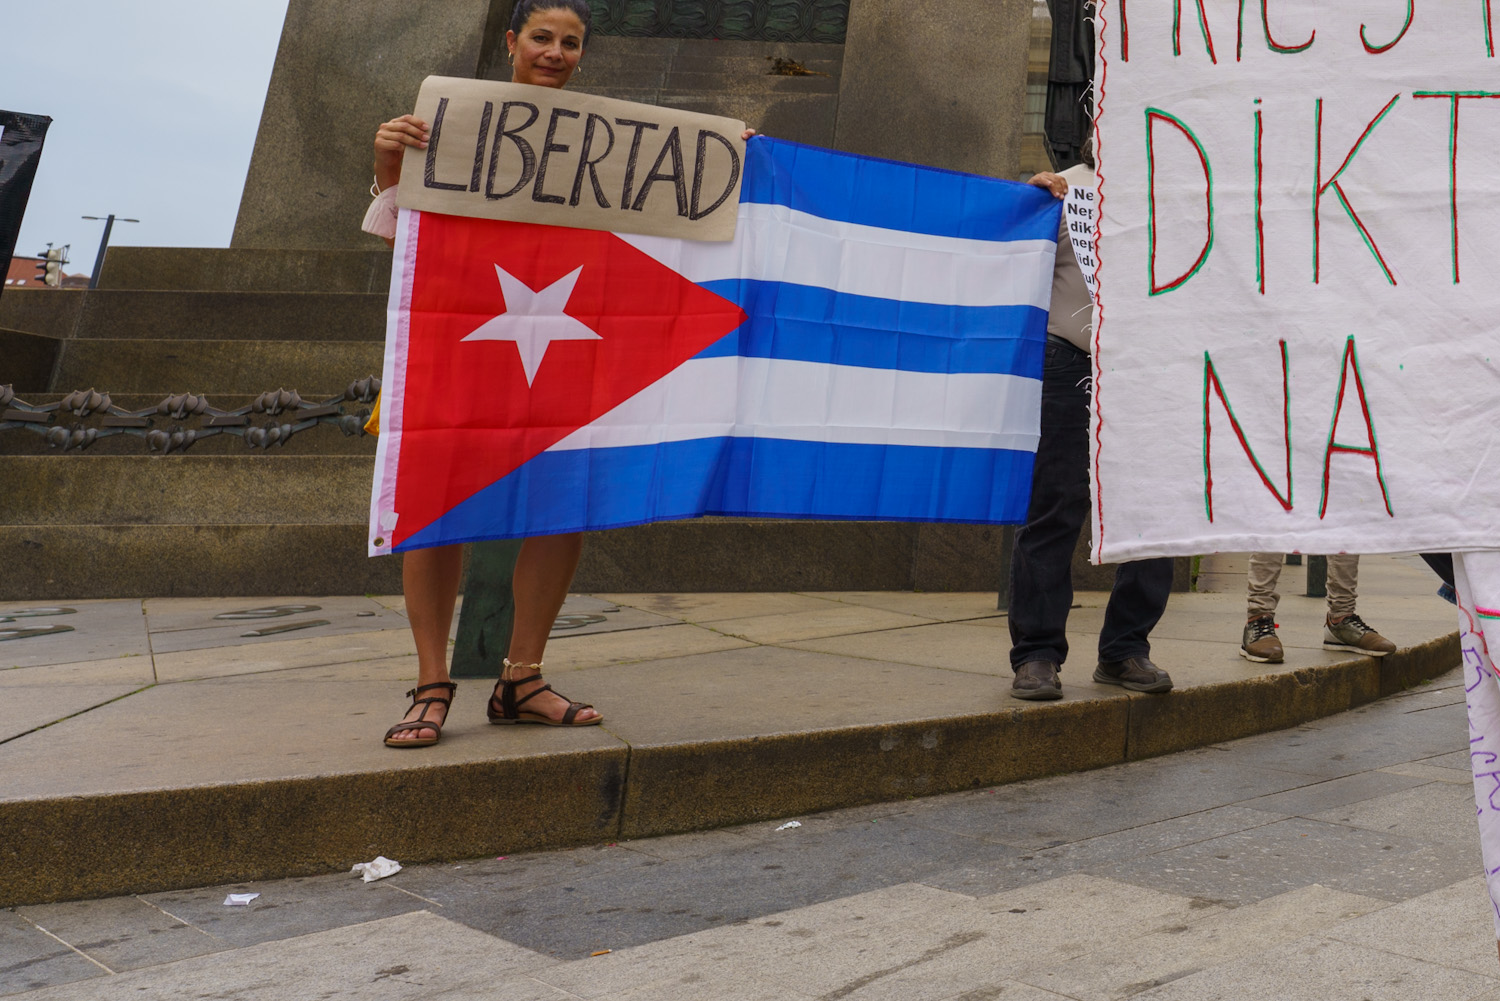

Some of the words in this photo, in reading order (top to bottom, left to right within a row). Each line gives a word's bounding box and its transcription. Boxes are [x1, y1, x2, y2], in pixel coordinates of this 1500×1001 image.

[424, 97, 740, 221] LIBERTAD
[1070, 221, 1095, 234] dik
[1203, 334, 1394, 523] NA
